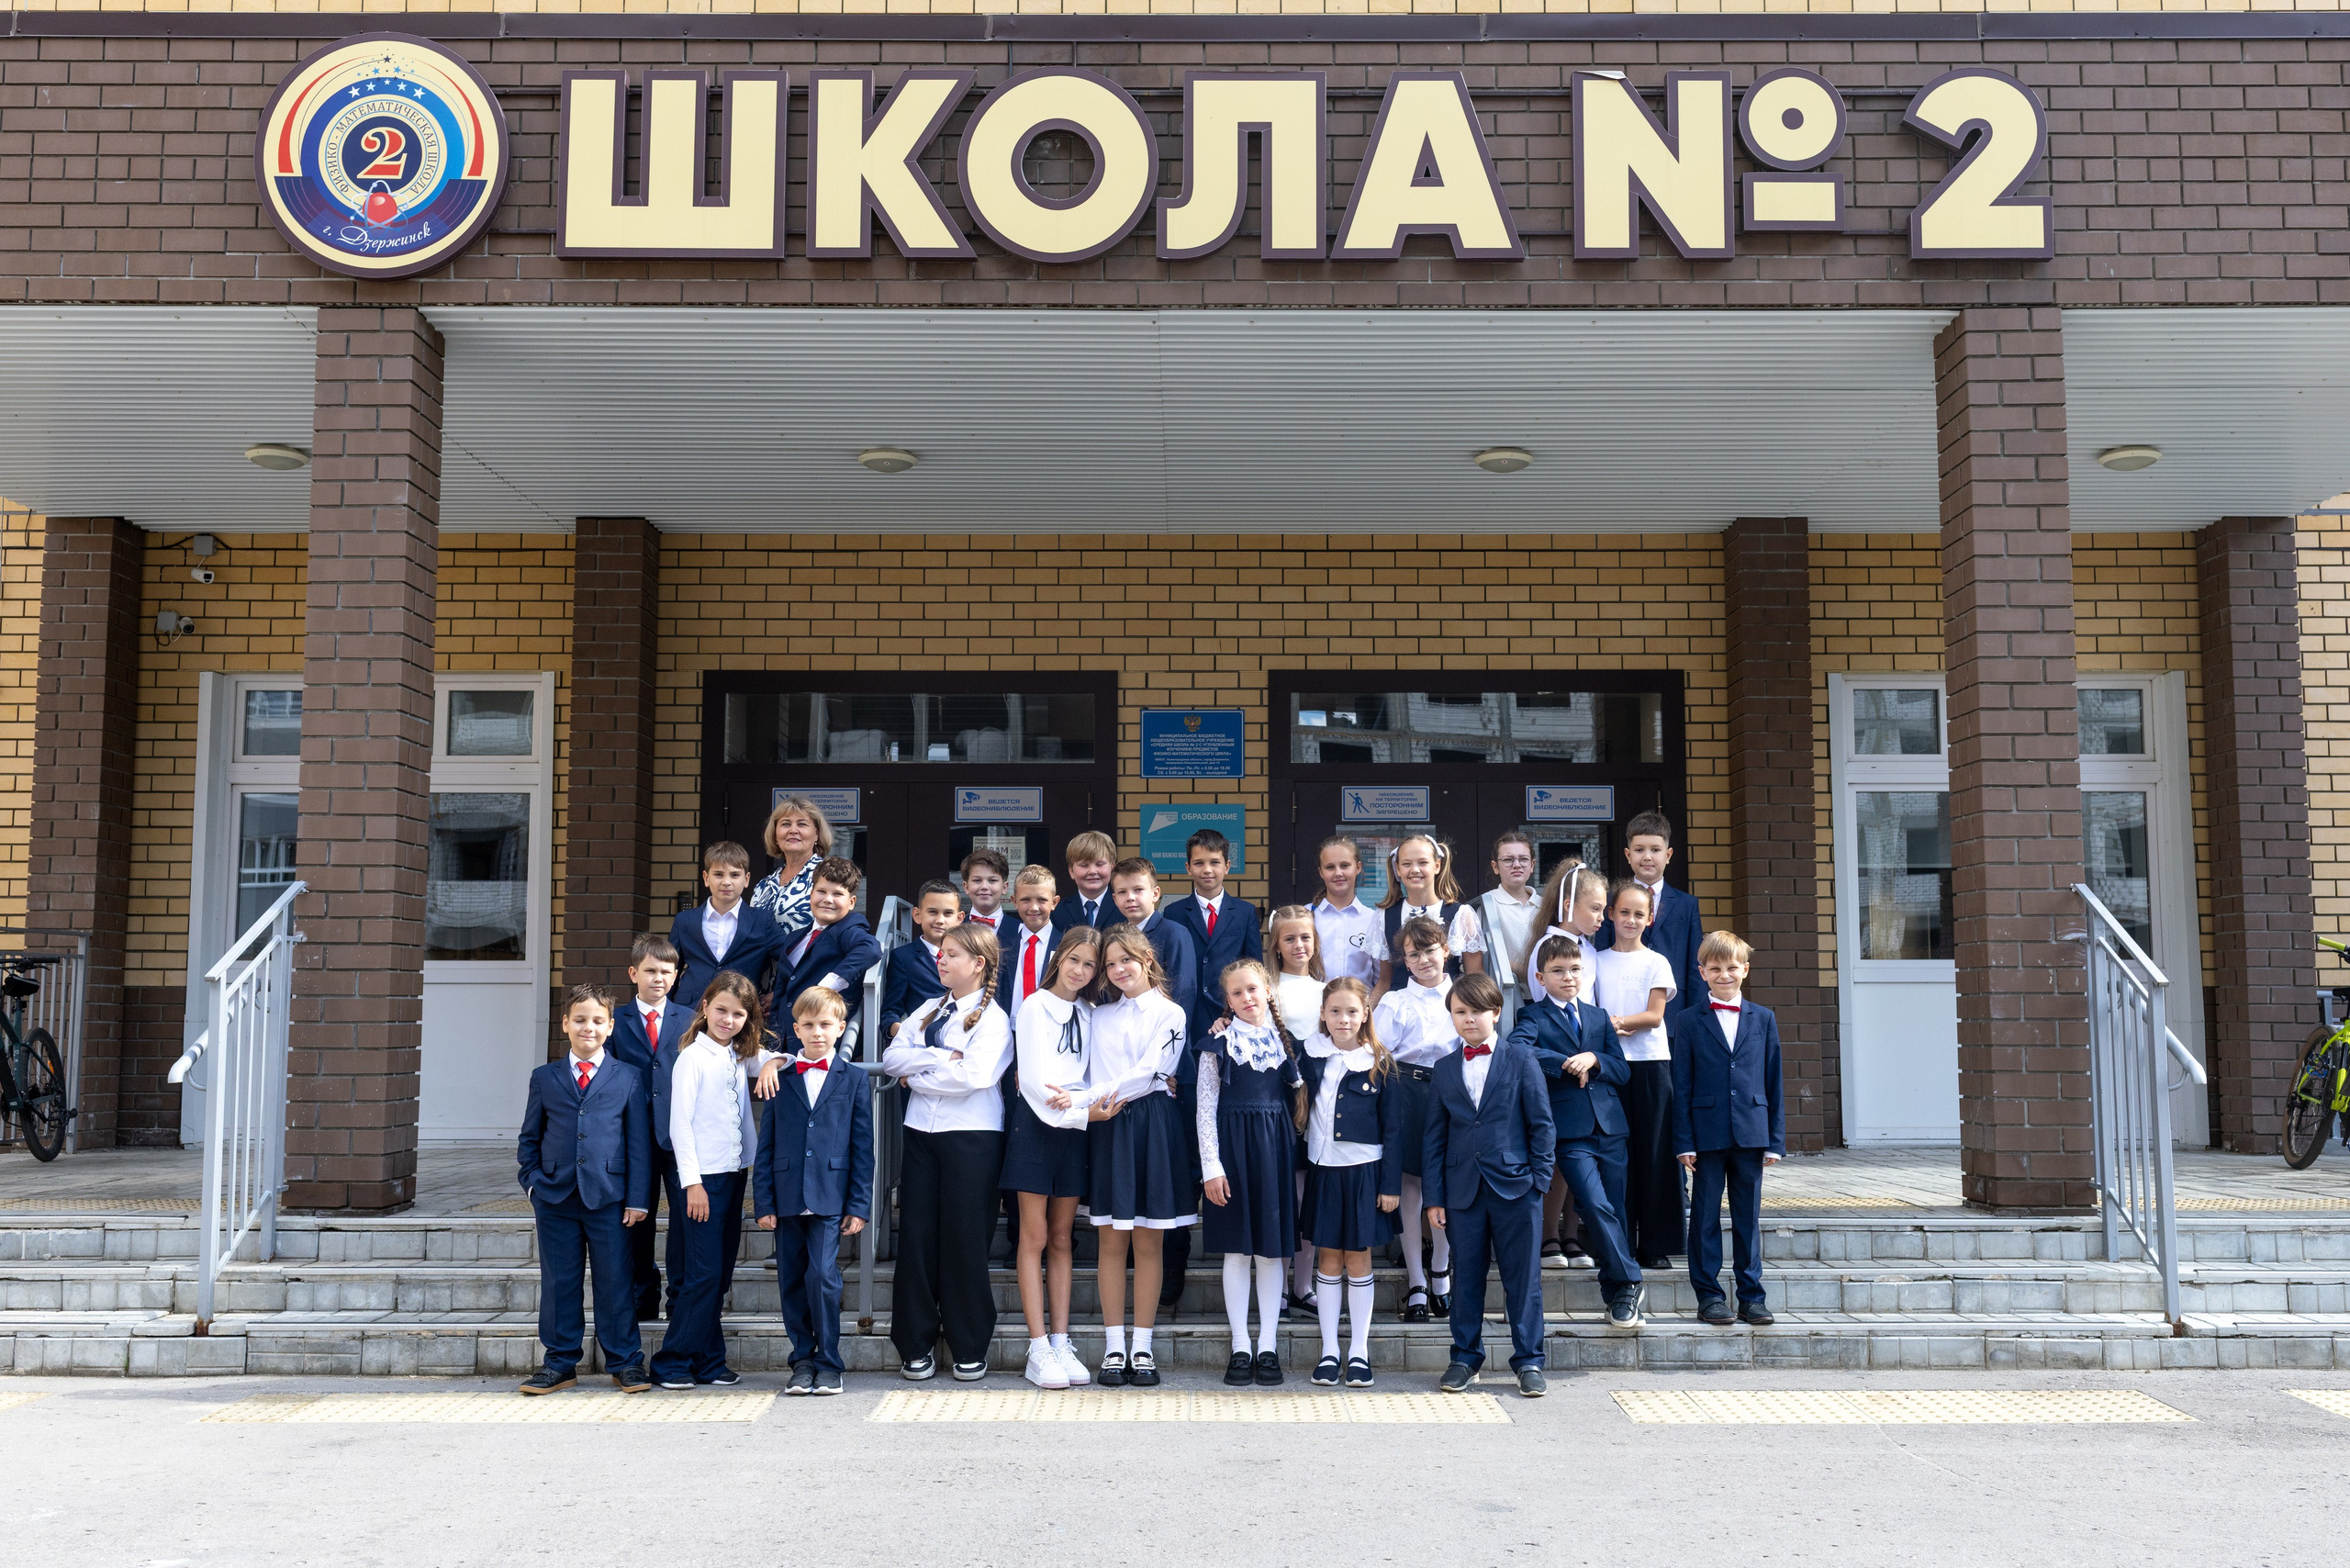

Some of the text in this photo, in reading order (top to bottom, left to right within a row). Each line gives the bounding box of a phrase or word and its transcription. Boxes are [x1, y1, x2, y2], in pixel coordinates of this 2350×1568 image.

[335, 101, 437, 148] МАТЕМАТИЧЕСКАЯ
[327, 142, 349, 193] ФИЗИКО
[356, 126, 408, 180] 2
[409, 151, 438, 195] ШКОЛА
[556, 65, 1525, 265] ШКОЛА
[1900, 67, 2055, 263] 2
[322, 221, 432, 253] г. Дзержинск
